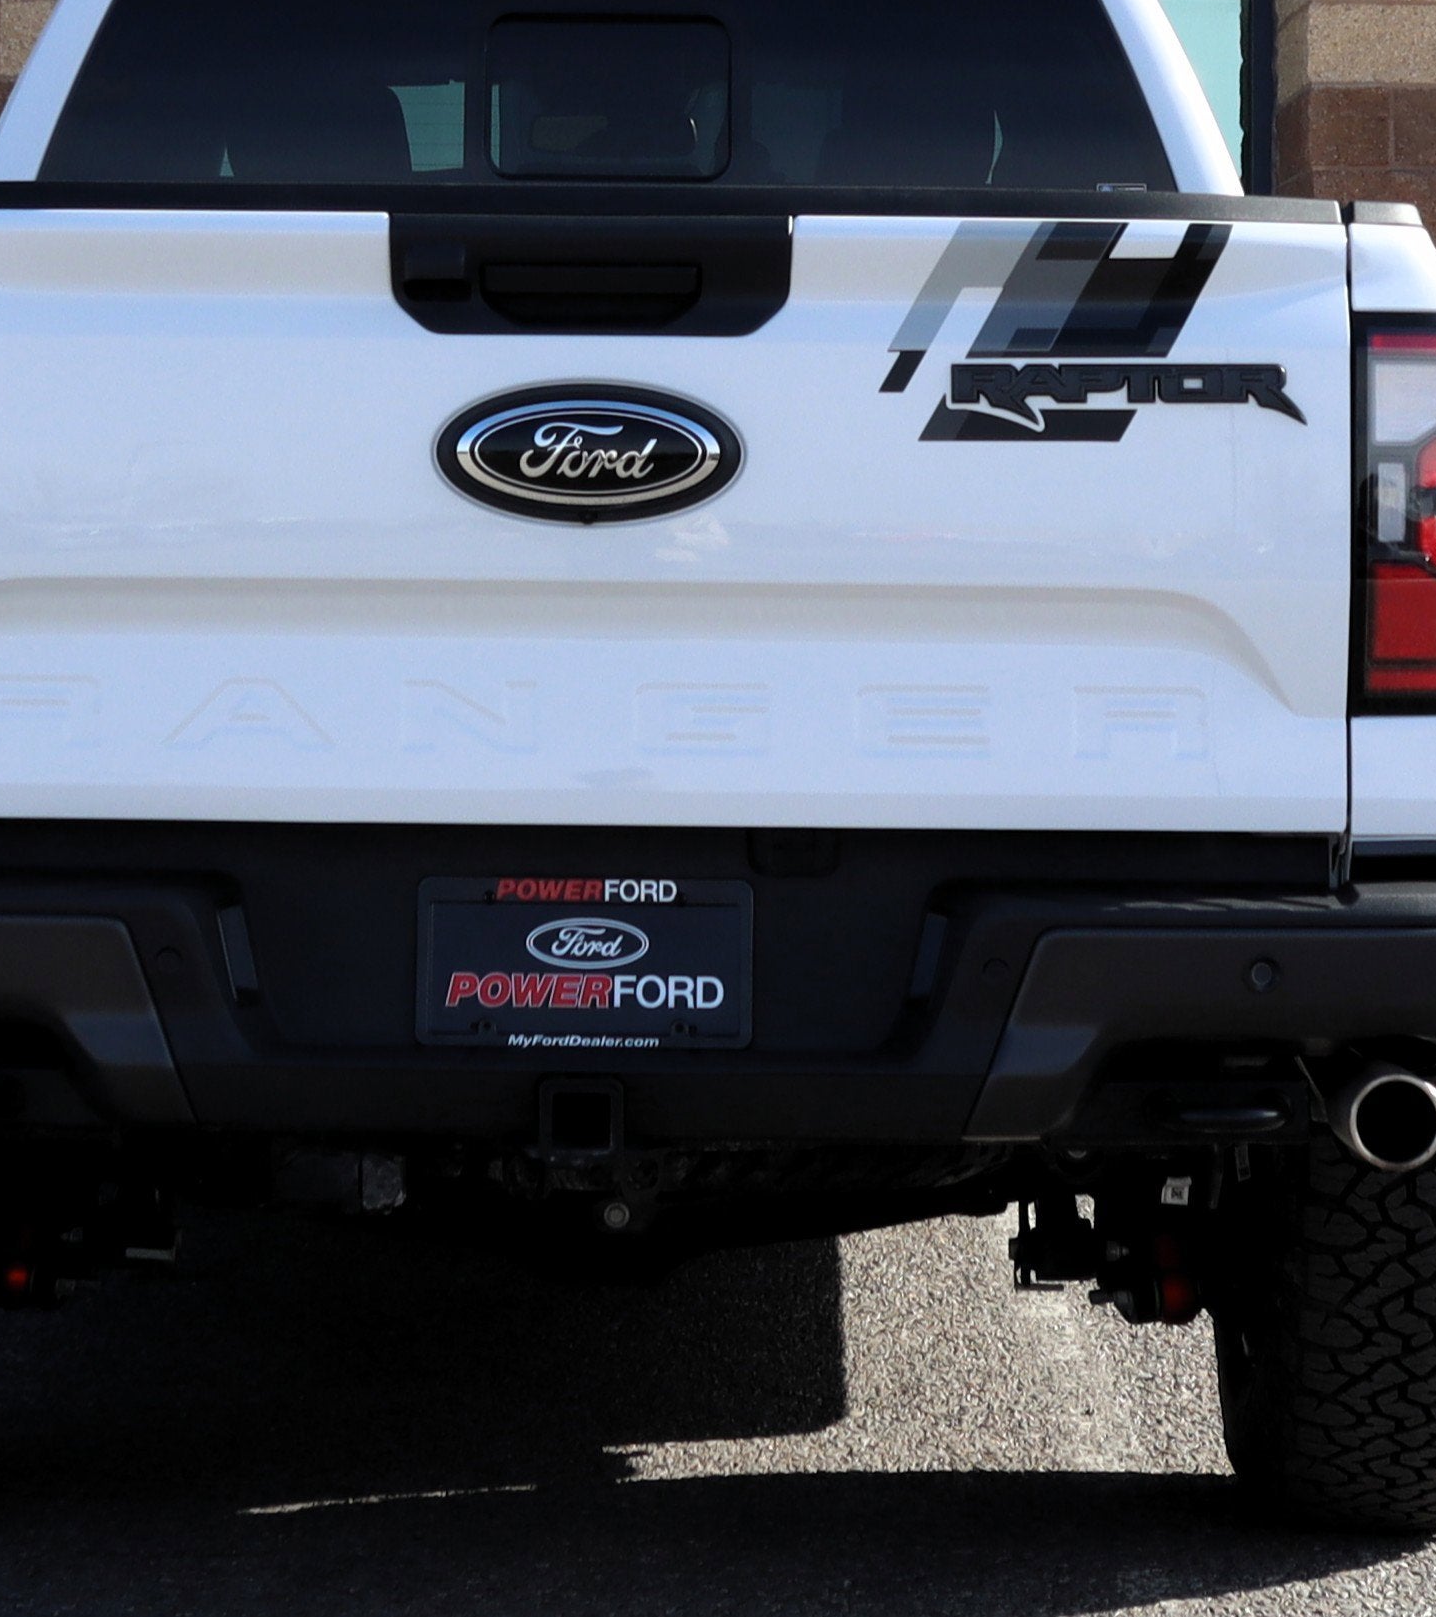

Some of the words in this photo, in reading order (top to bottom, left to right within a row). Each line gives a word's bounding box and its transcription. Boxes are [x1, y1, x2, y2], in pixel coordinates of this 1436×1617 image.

[950, 362, 1308, 426] RAPTOR
[519, 422, 654, 481] Ford
[494, 878, 678, 903] POWERFORD
[550, 926, 623, 958] Ford
[445, 971, 725, 1009] POWERFORD
[507, 1034, 660, 1049] MyFordDealer.com
